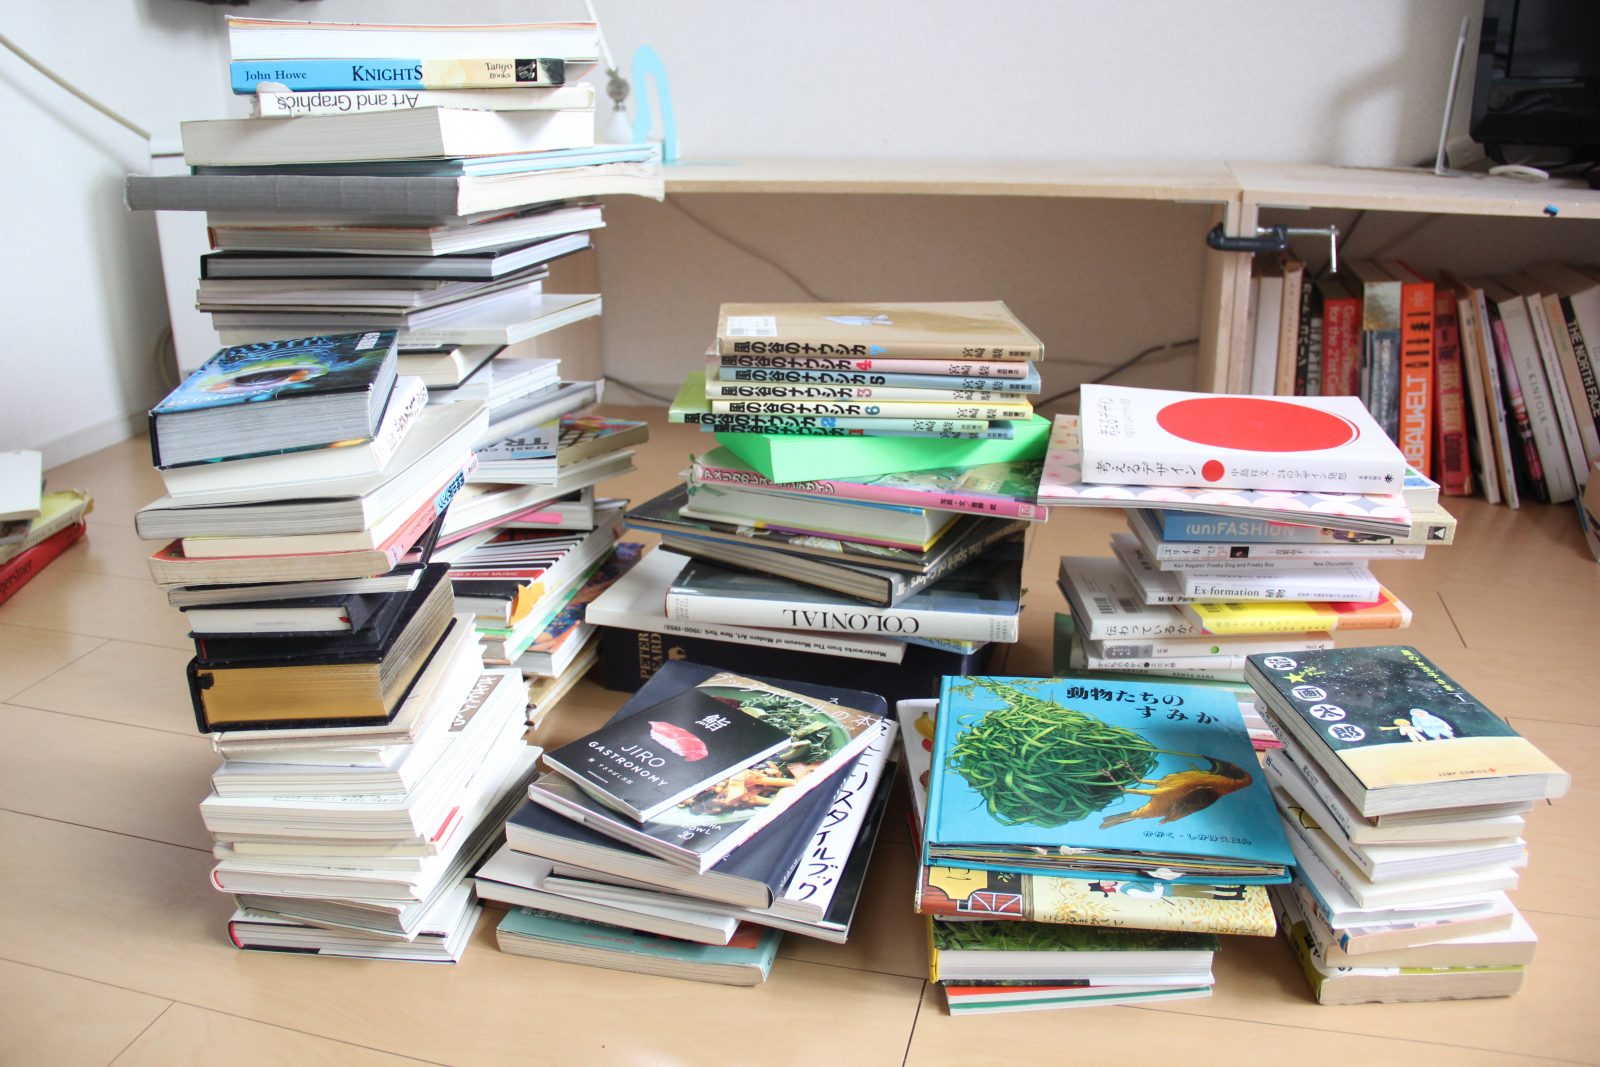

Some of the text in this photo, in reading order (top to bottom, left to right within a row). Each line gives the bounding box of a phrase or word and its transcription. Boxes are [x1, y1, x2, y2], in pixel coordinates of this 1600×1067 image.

[245, 69, 308, 82] John Howe
[485, 62, 514, 73] Tango
[489, 70, 512, 80] Books
[277, 93, 419, 111] Art and Graphics
[1328, 306, 1342, 324] for
[1328, 326, 1340, 348] the
[734, 341, 867, 356] 風の谷のナウシカ
[870, 344, 886, 355] 7
[1307, 326, 1322, 387] HAPTIC
[721, 355, 852, 370] 風の谷のナウシカ
[856, 360, 872, 371] 4
[1566, 320, 1600, 418] THE NORTH FACE
[735, 370, 866, 385] 風の谷のナウシカ
[870, 376, 886, 386] 5
[721, 386, 853, 399] 風の谷のナウシカ
[856, 388, 872, 398] 3
[1526, 373, 1549, 424] KINFOLK
[729, 402, 861, 416] 風の谷のナウシカ
[865, 405, 881, 416] 6
[684, 413, 816, 428] 風の谷のナウシカ
[820, 417, 837, 428] 2
[1404, 373, 1427, 474] UBAUWELT
[1095, 459, 1197, 478] 考えるデザイン
[1185, 522, 1296, 538] (un)FASHION
[1194, 584, 1260, 597] Ex-formation
[782, 607, 920, 635] COLONIAL
[749, 635, 774, 643] Modern
[784, 639, 811, 647] Museum
[639, 632, 651, 679] PETER
[650, 632, 663, 673] EARD
[843, 646, 887, 659] Masterworks
[1066, 686, 1185, 707] 動物たちの
[695, 713, 731, 732] 鮨
[1135, 705, 1219, 725] すみか
[588, 741, 668, 787] GASTRONOMY
[620, 744, 666, 768] JIRO
